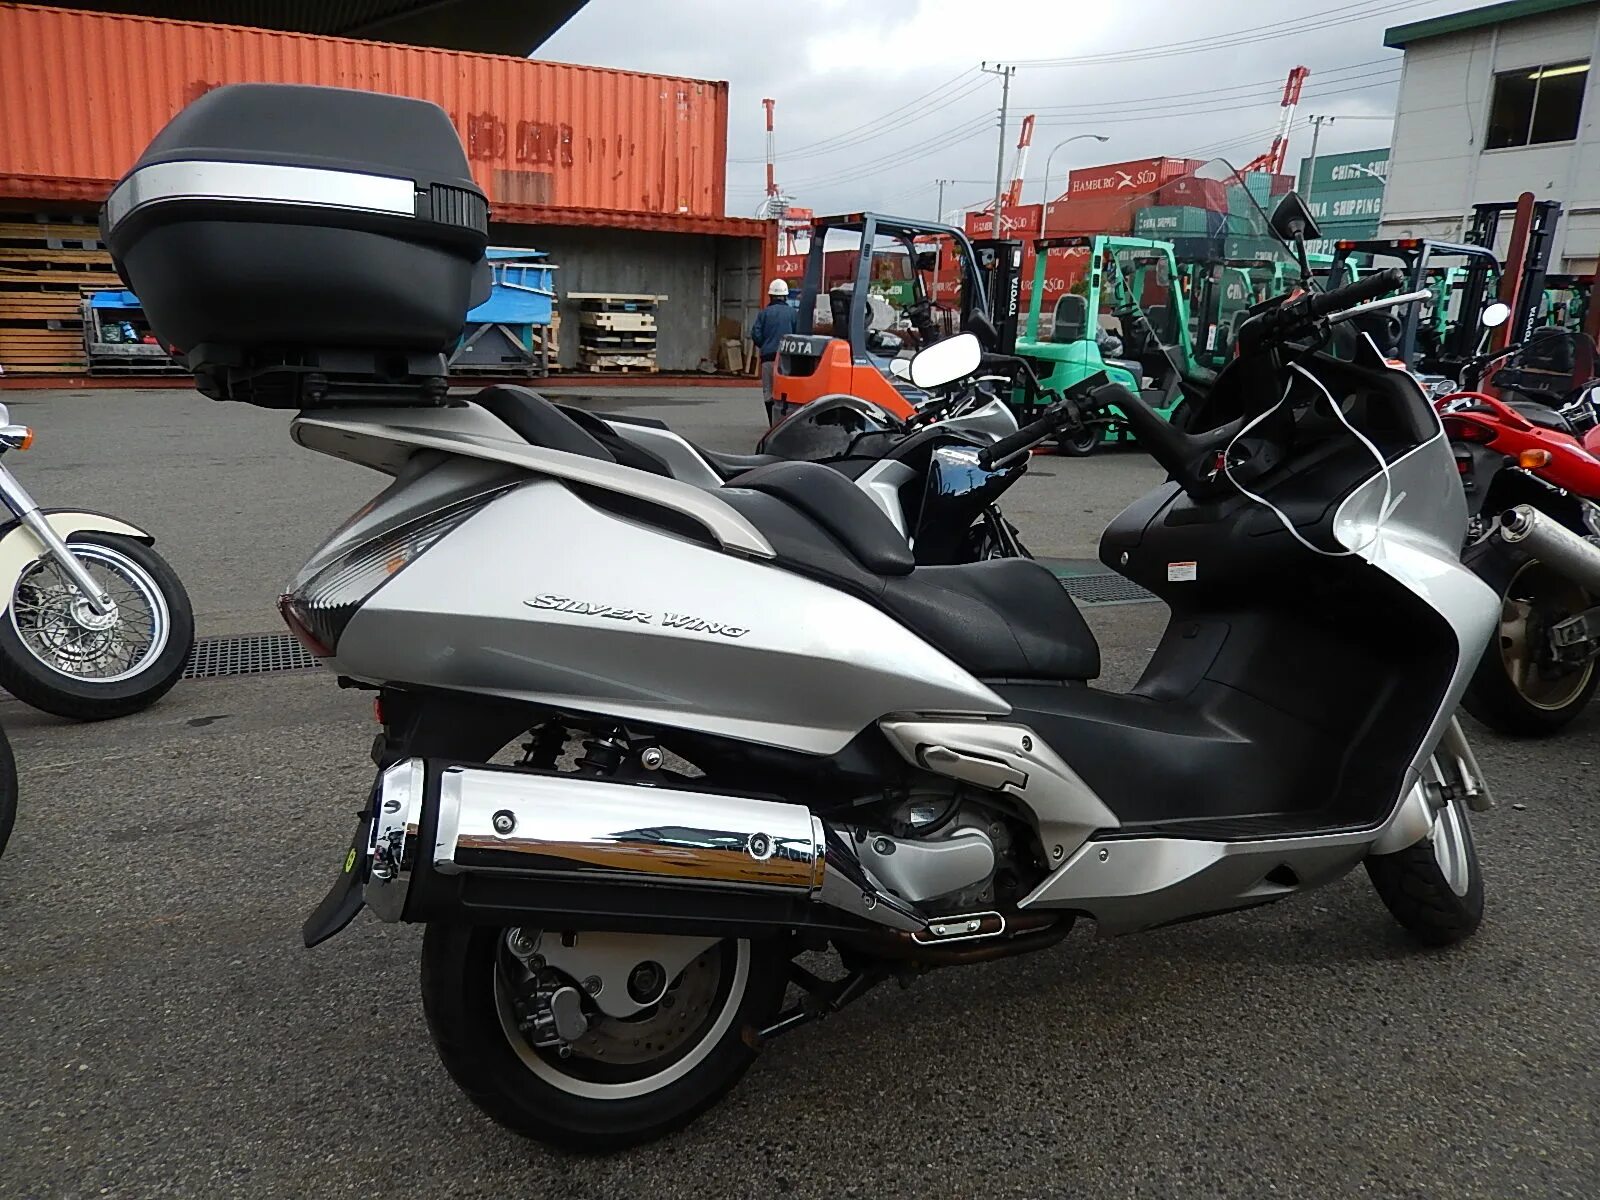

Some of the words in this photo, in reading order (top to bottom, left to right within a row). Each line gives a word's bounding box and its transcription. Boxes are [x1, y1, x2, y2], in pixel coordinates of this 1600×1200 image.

[1073, 177, 1114, 192] HAMBURG
[1331, 164, 1360, 181] CHINA
[1333, 198, 1381, 216] SHIPPING
[1008, 277, 1019, 317] TOYOTA
[1523, 306, 1537, 343] TOYOTA
[523, 592, 653, 625] SILVER
